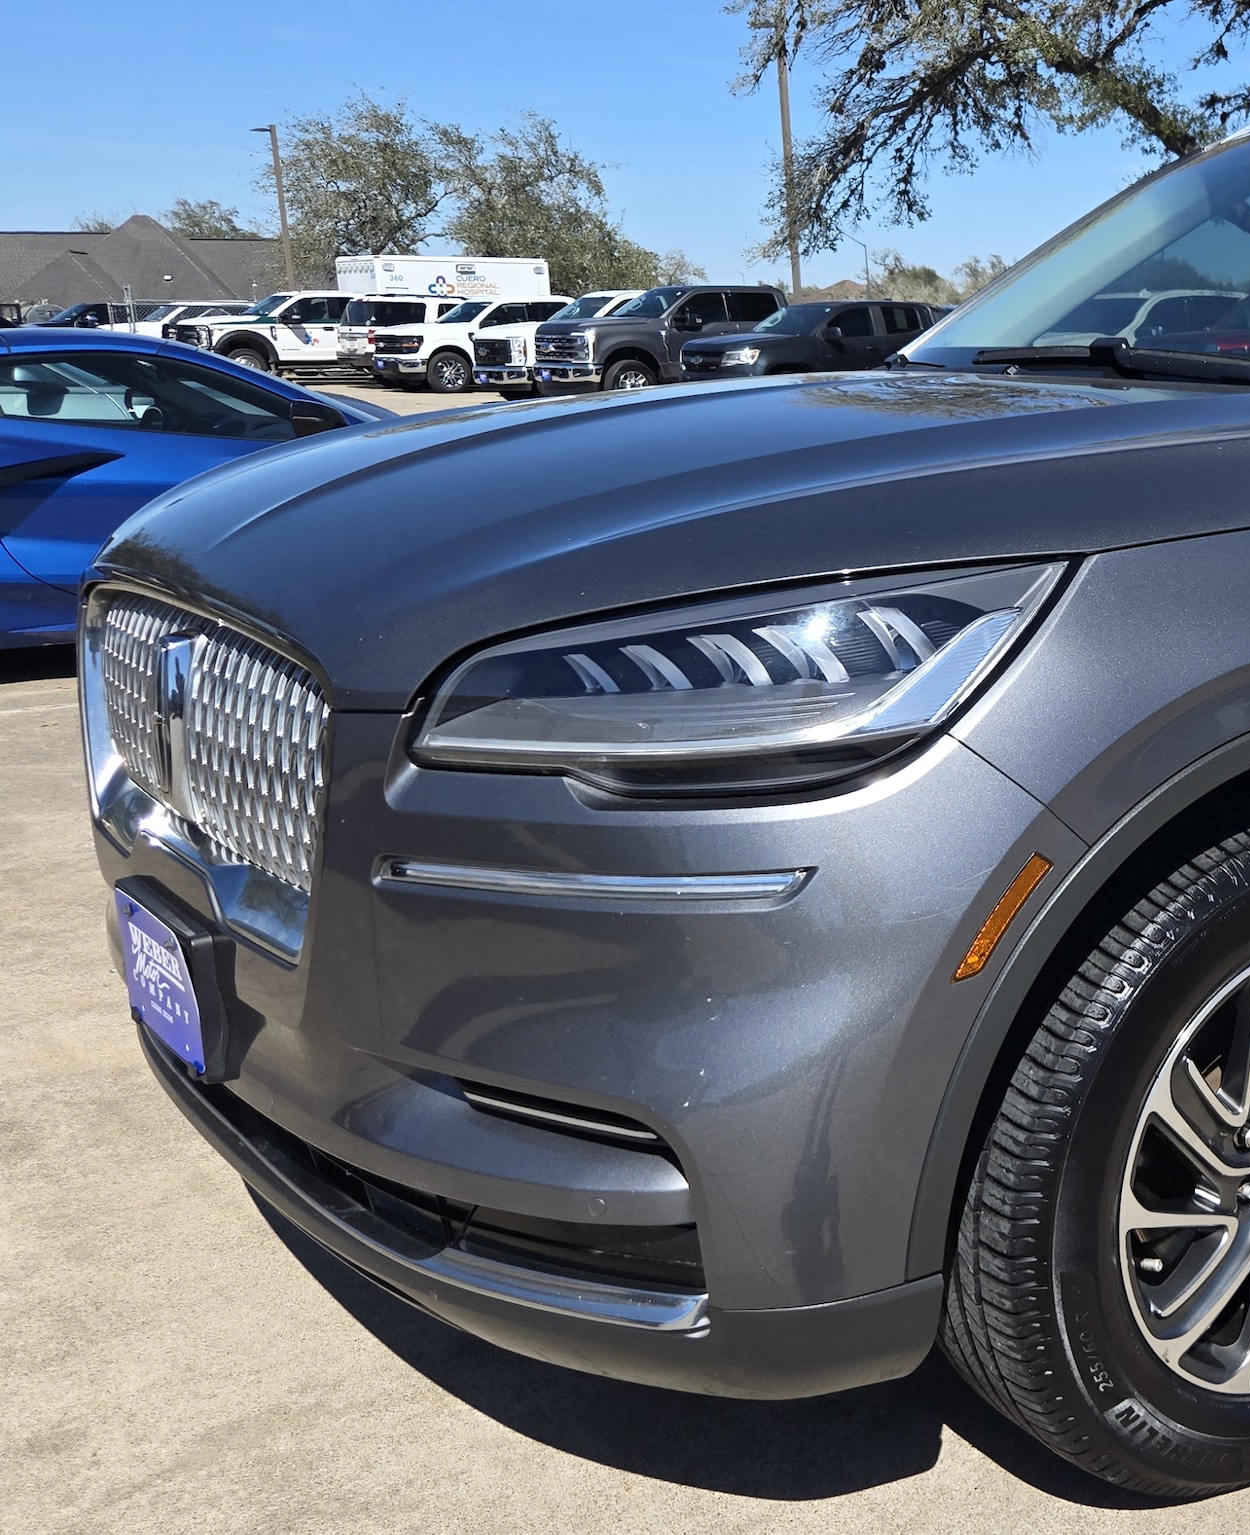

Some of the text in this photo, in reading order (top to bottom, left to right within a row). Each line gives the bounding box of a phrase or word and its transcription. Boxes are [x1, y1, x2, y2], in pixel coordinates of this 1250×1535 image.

[389, 274, 404, 282] 360
[128, 921, 183, 981] WEBER
[133, 968, 189, 1024] COMPANY
